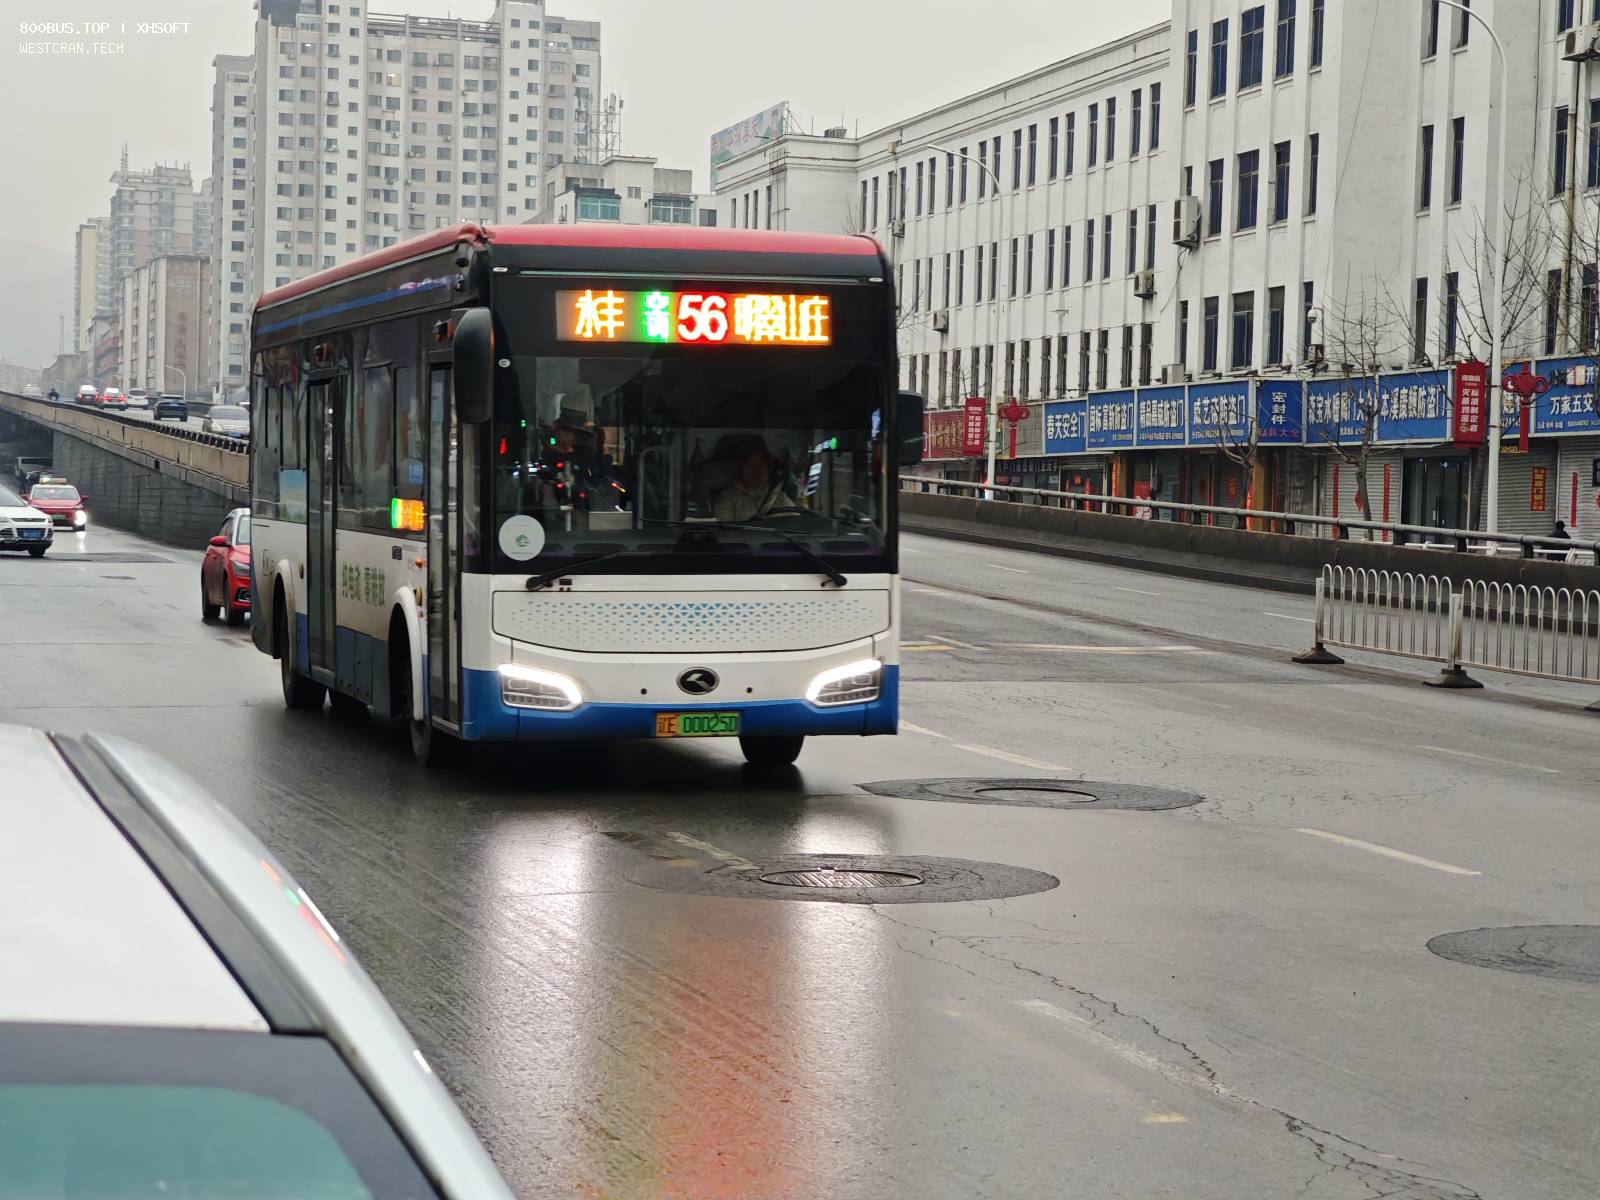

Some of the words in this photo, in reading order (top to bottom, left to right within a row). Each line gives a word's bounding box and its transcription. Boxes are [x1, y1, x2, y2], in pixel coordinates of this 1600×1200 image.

[575, 290, 624, 338] 永丰
[677, 295, 727, 341] 56
[1047, 411, 1086, 439] 春天安全门
[1271, 391, 1288, 425] 密封件
